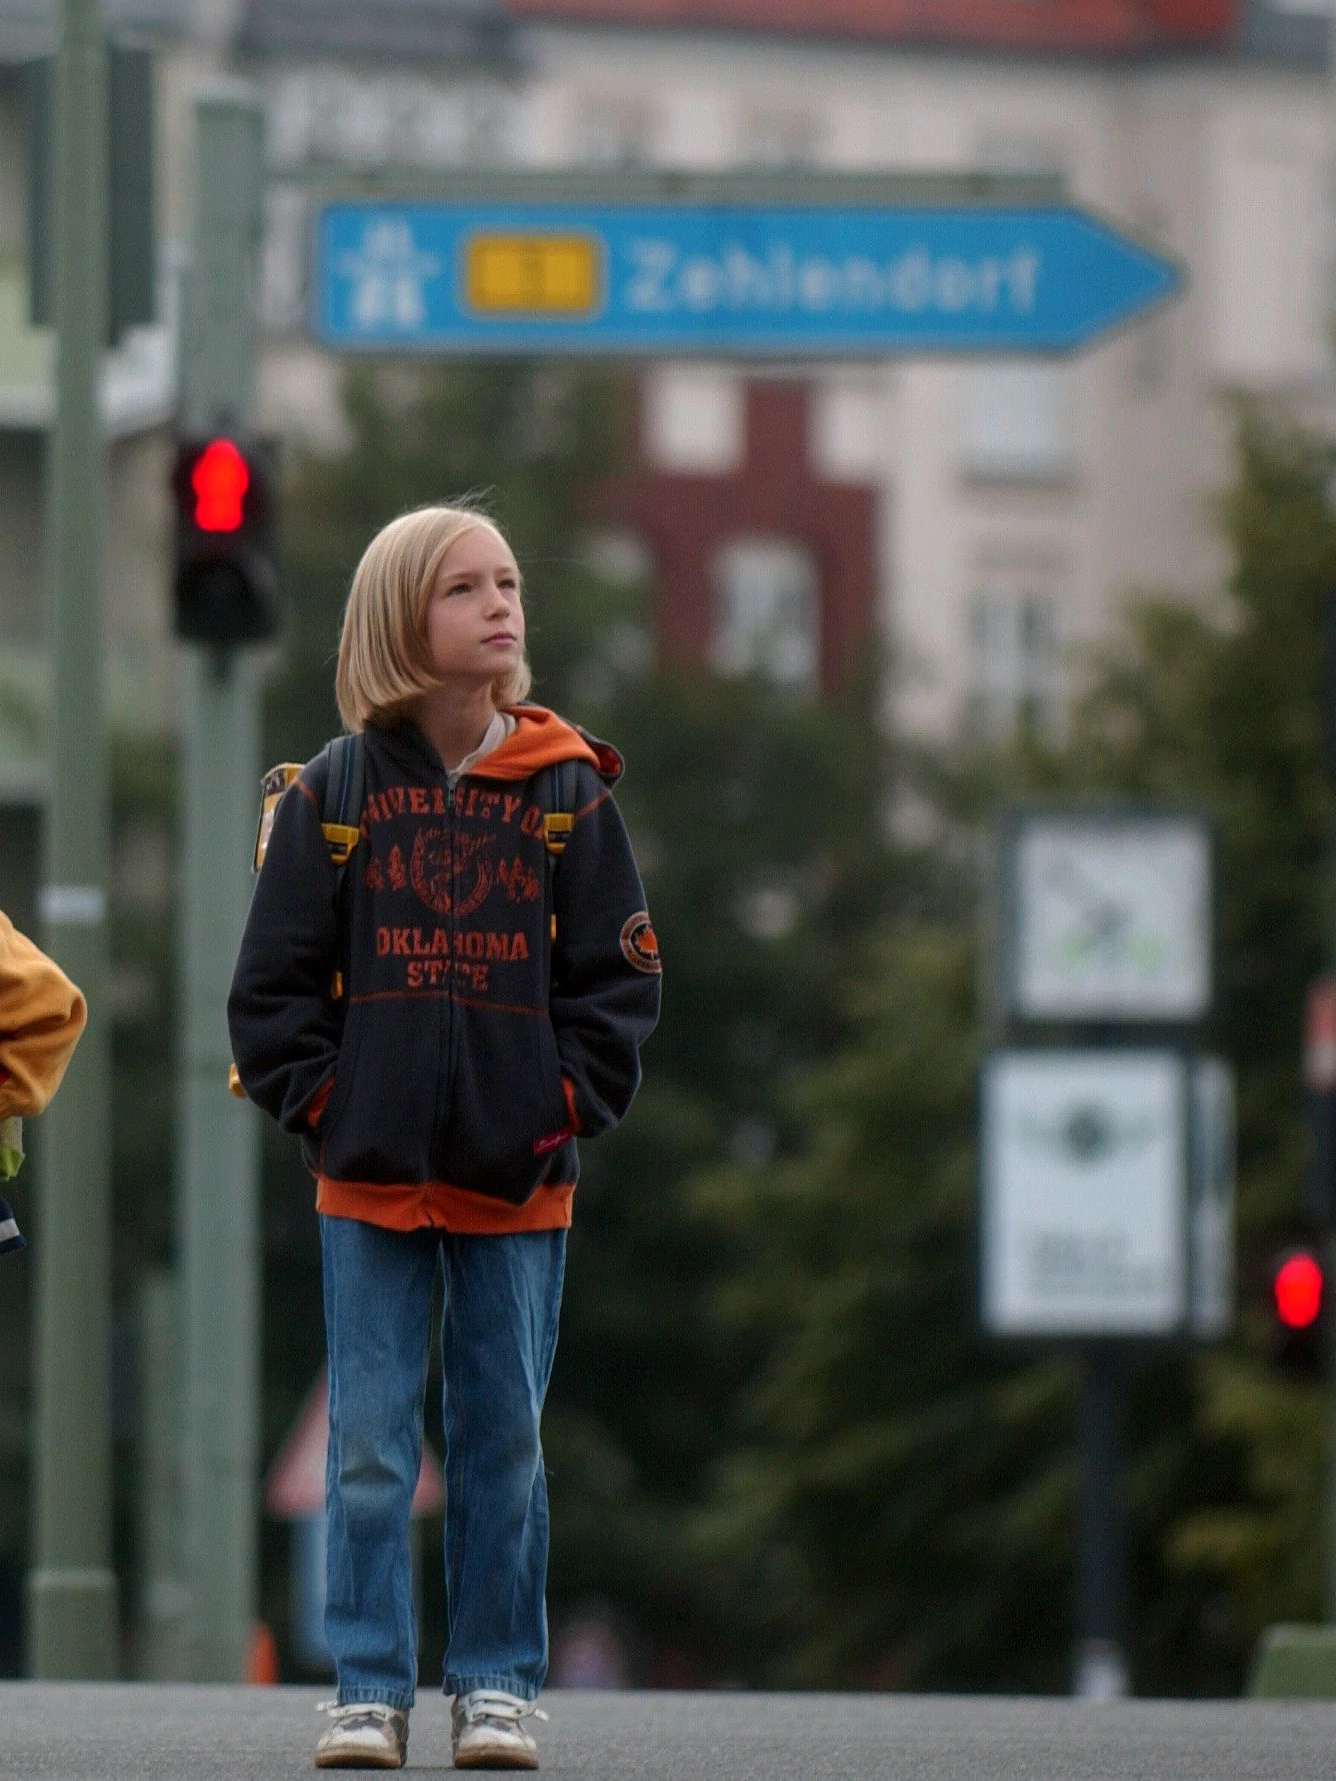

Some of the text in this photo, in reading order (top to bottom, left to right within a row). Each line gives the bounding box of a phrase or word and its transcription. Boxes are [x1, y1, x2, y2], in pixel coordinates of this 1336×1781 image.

[627, 239, 1039, 312] Zehlendorf
[360, 786, 521, 839] NIVERSITY
[376, 926, 529, 961] OKLAHOMA
